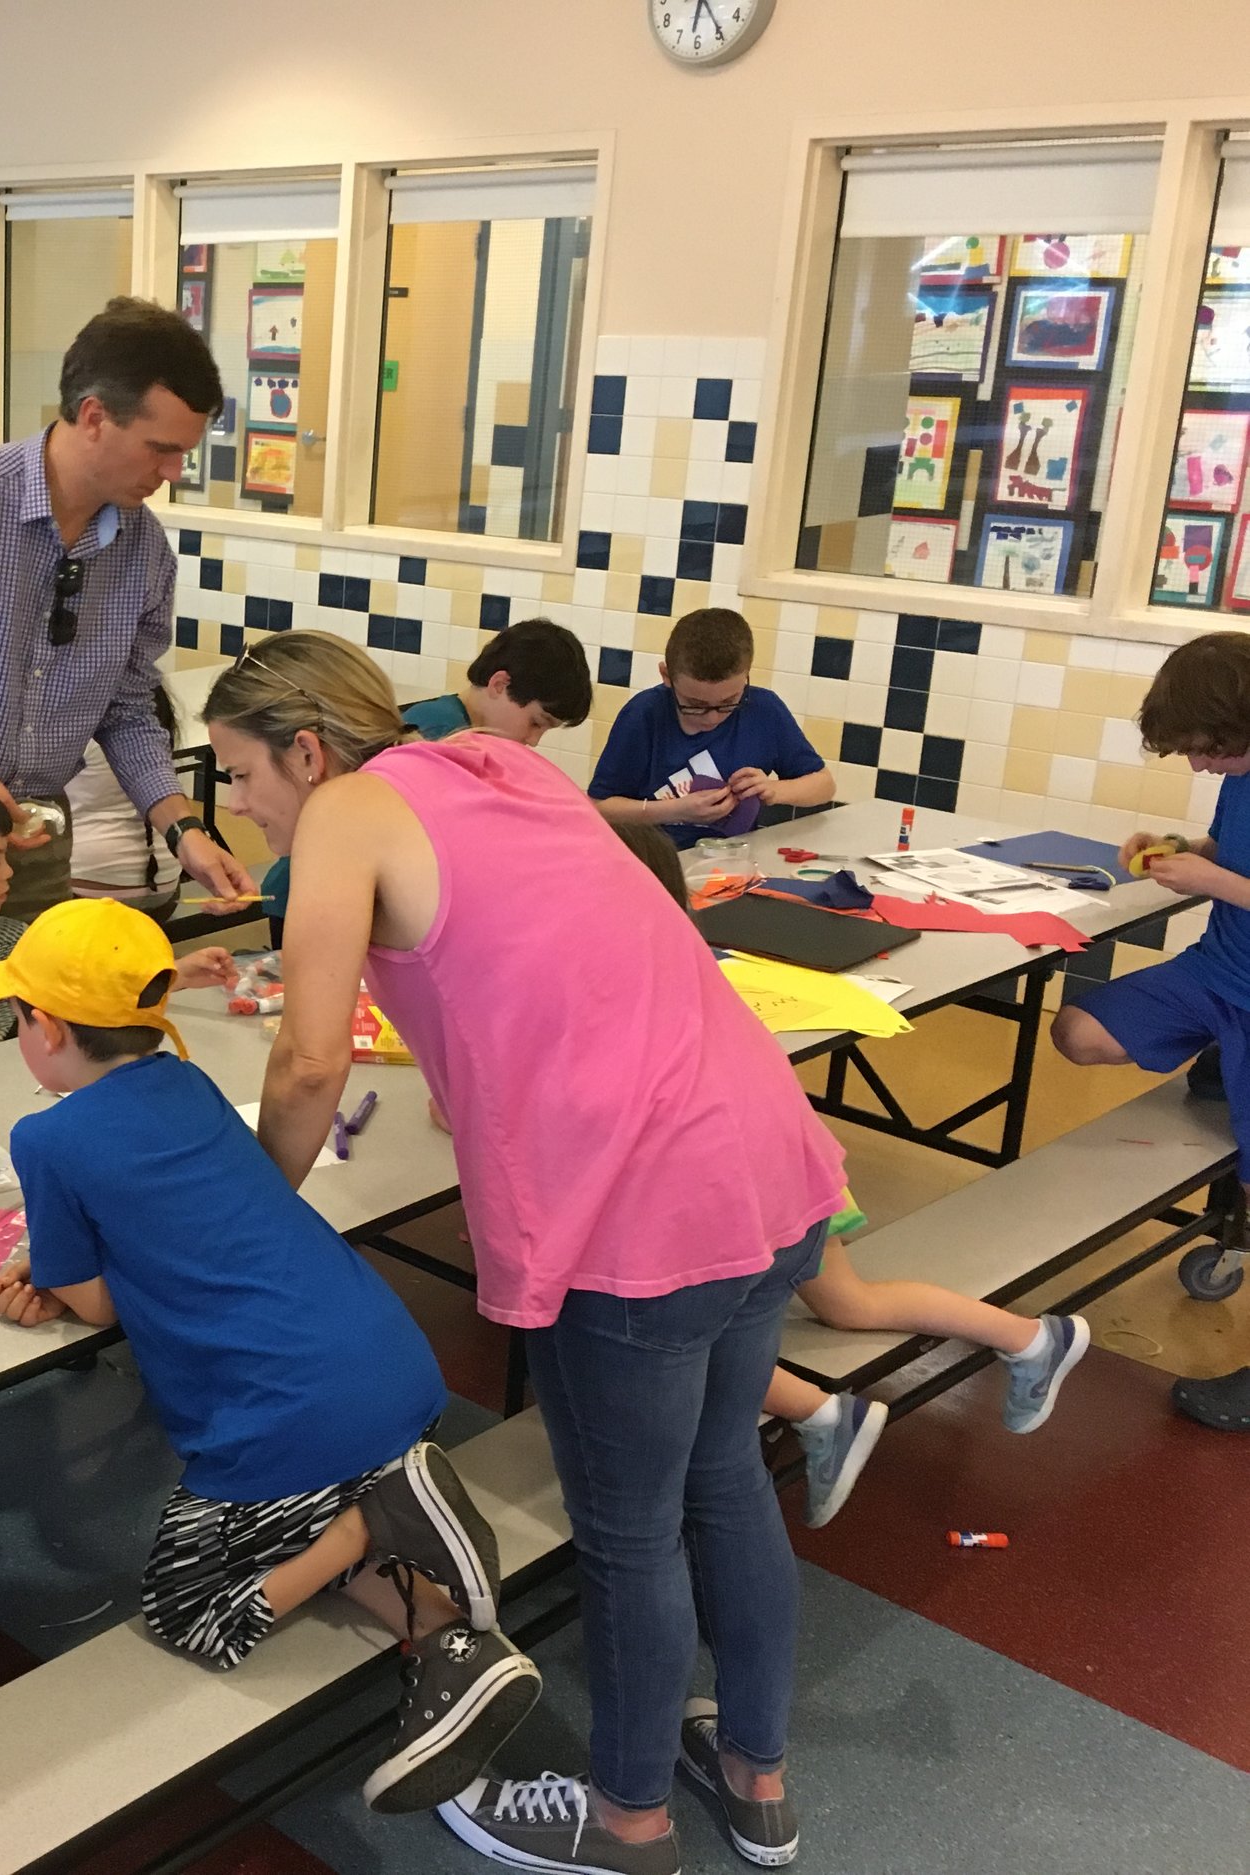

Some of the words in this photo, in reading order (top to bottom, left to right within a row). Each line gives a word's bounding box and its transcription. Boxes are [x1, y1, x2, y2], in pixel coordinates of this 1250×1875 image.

[663, 13, 671, 28] 8
[732, 7, 741, 22] 4
[676, 29, 683, 45] 7
[693, 35, 701, 50] 6
